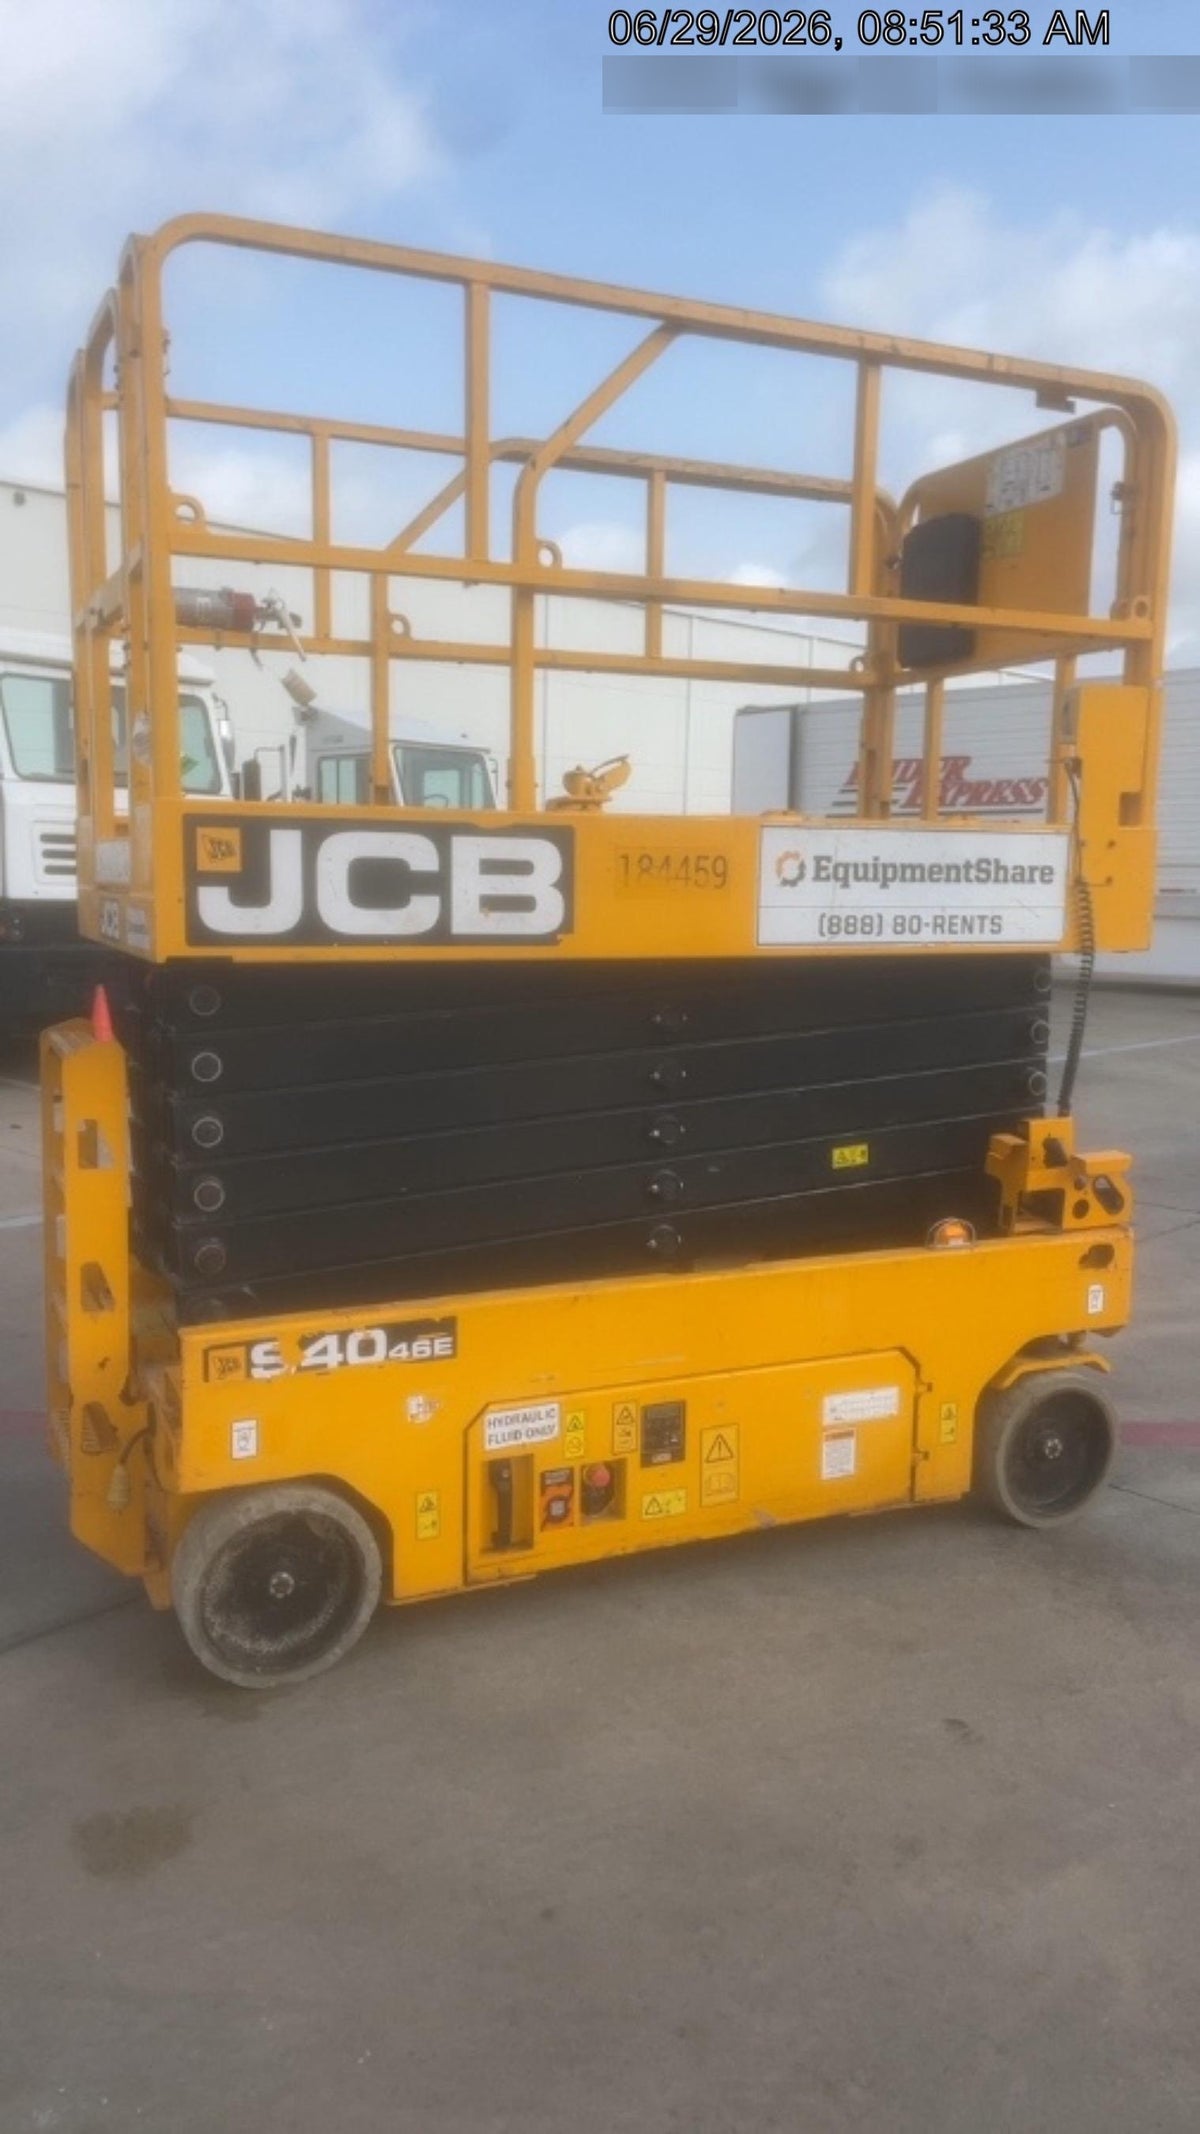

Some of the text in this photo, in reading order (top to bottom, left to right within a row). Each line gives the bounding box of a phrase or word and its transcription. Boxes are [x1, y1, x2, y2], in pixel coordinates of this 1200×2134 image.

[196, 829, 566, 936] JCB
[619, 852, 729, 890] 184459
[812, 854, 1054, 890] EquipmentShare
[817, 912, 1004, 937] (888) 80-RENTS
